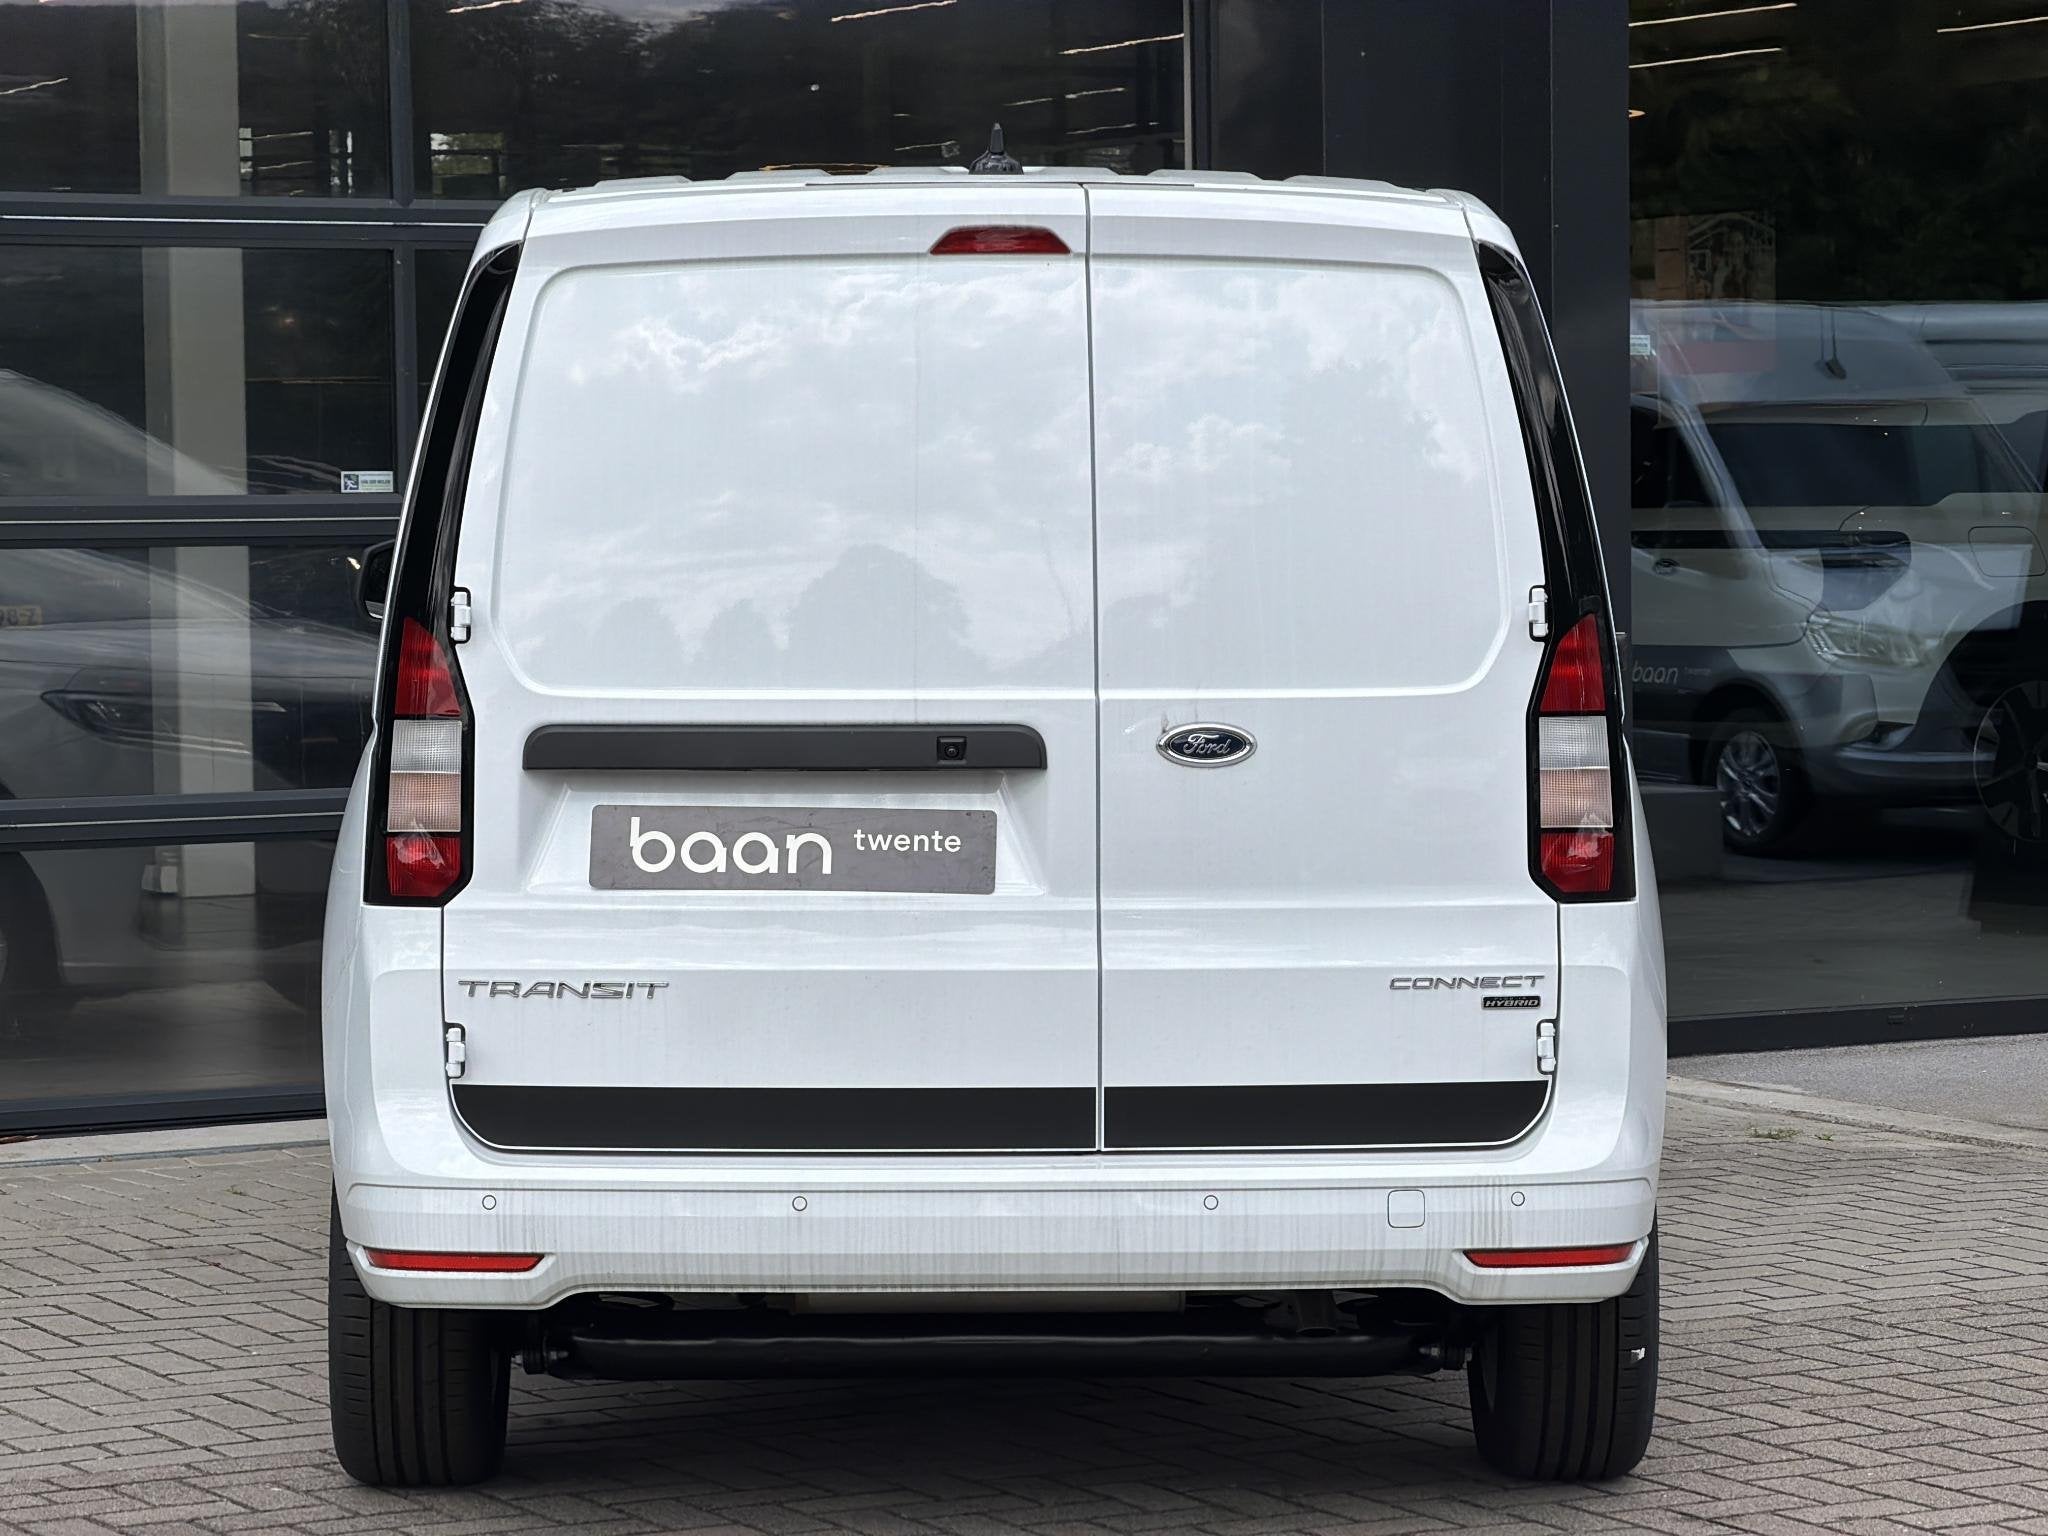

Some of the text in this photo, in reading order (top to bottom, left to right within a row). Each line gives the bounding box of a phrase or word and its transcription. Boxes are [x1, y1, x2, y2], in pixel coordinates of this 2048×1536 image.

[1632, 660, 1678, 684] baan
[1182, 733, 1232, 754] Ford
[629, 816, 962, 875] baan twente
[458, 980, 670, 999] TRANSIT
[1389, 975, 1545, 990] CONNECT
[1485, 999, 1539, 1007] HYBRID
